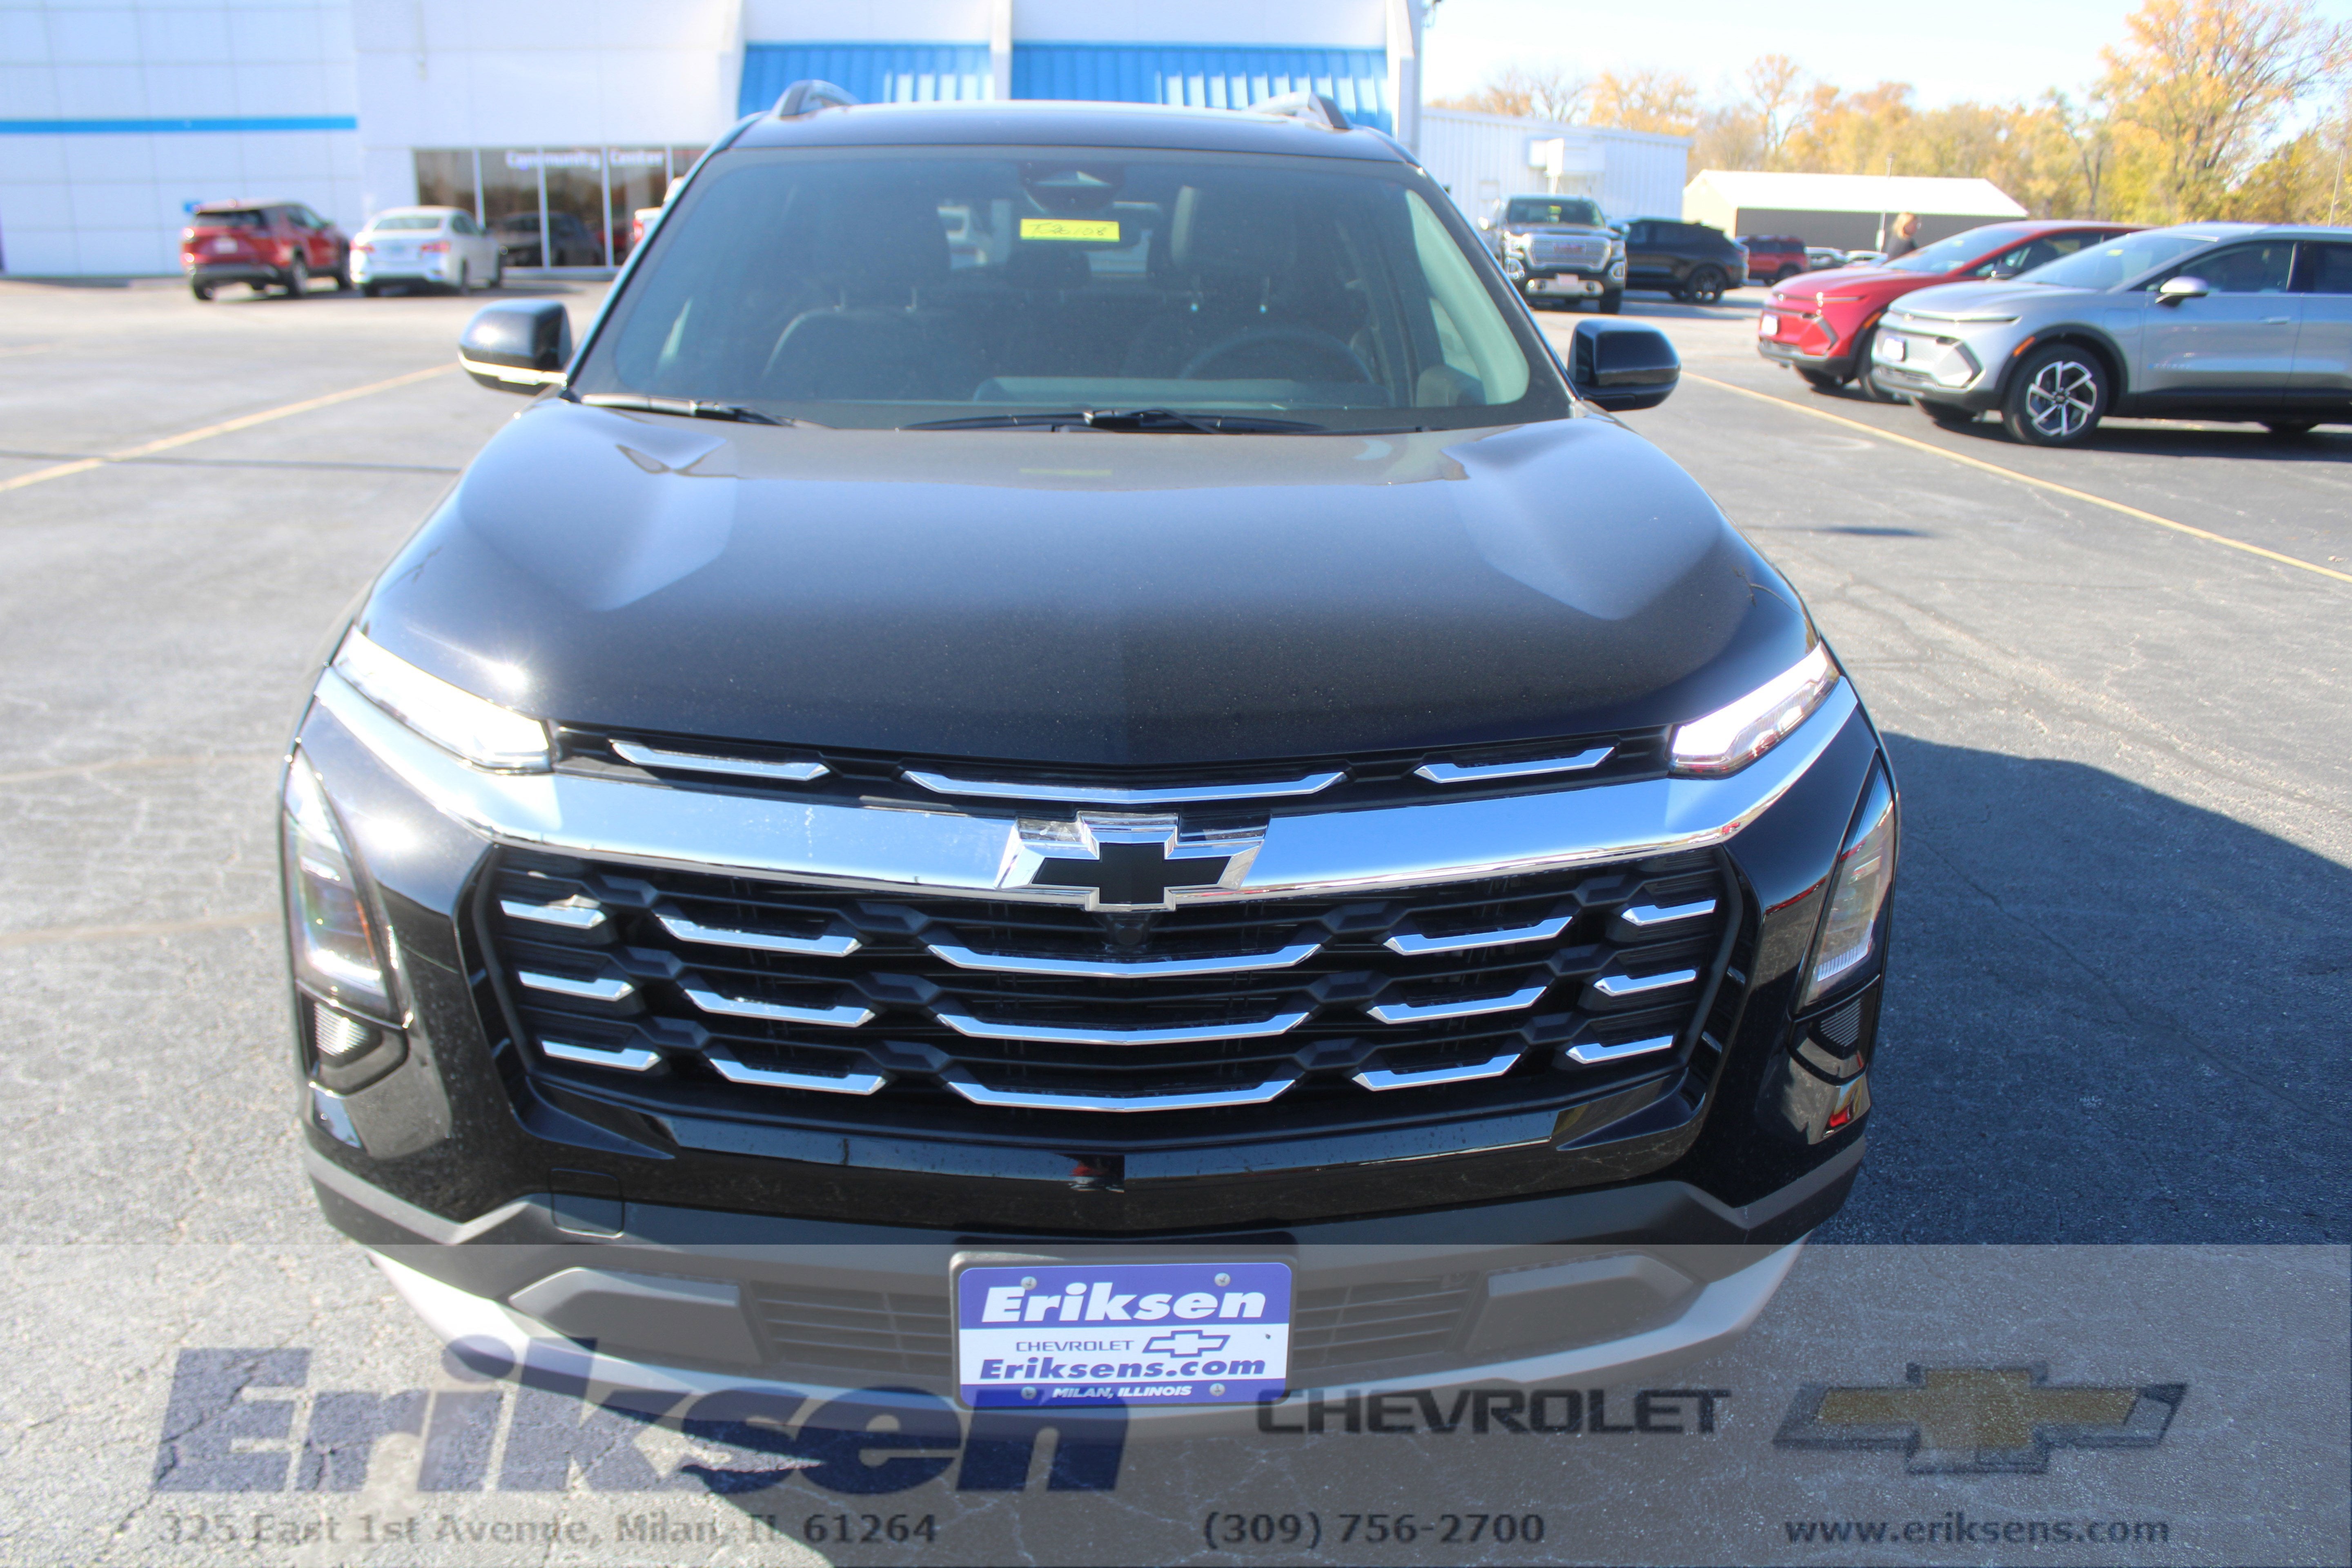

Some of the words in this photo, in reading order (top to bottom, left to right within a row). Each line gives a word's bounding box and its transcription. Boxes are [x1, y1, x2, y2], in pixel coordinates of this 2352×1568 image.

[981, 1282, 1265, 1322] Eriksen
[1016, 1340, 1134, 1352] CHEVROLET
[980, 1357, 1265, 1379] Eriksens.com
[1052, 1386, 1114, 1399] MILAN,
[1117, 1385, 1192, 1397] ILLINOIS
